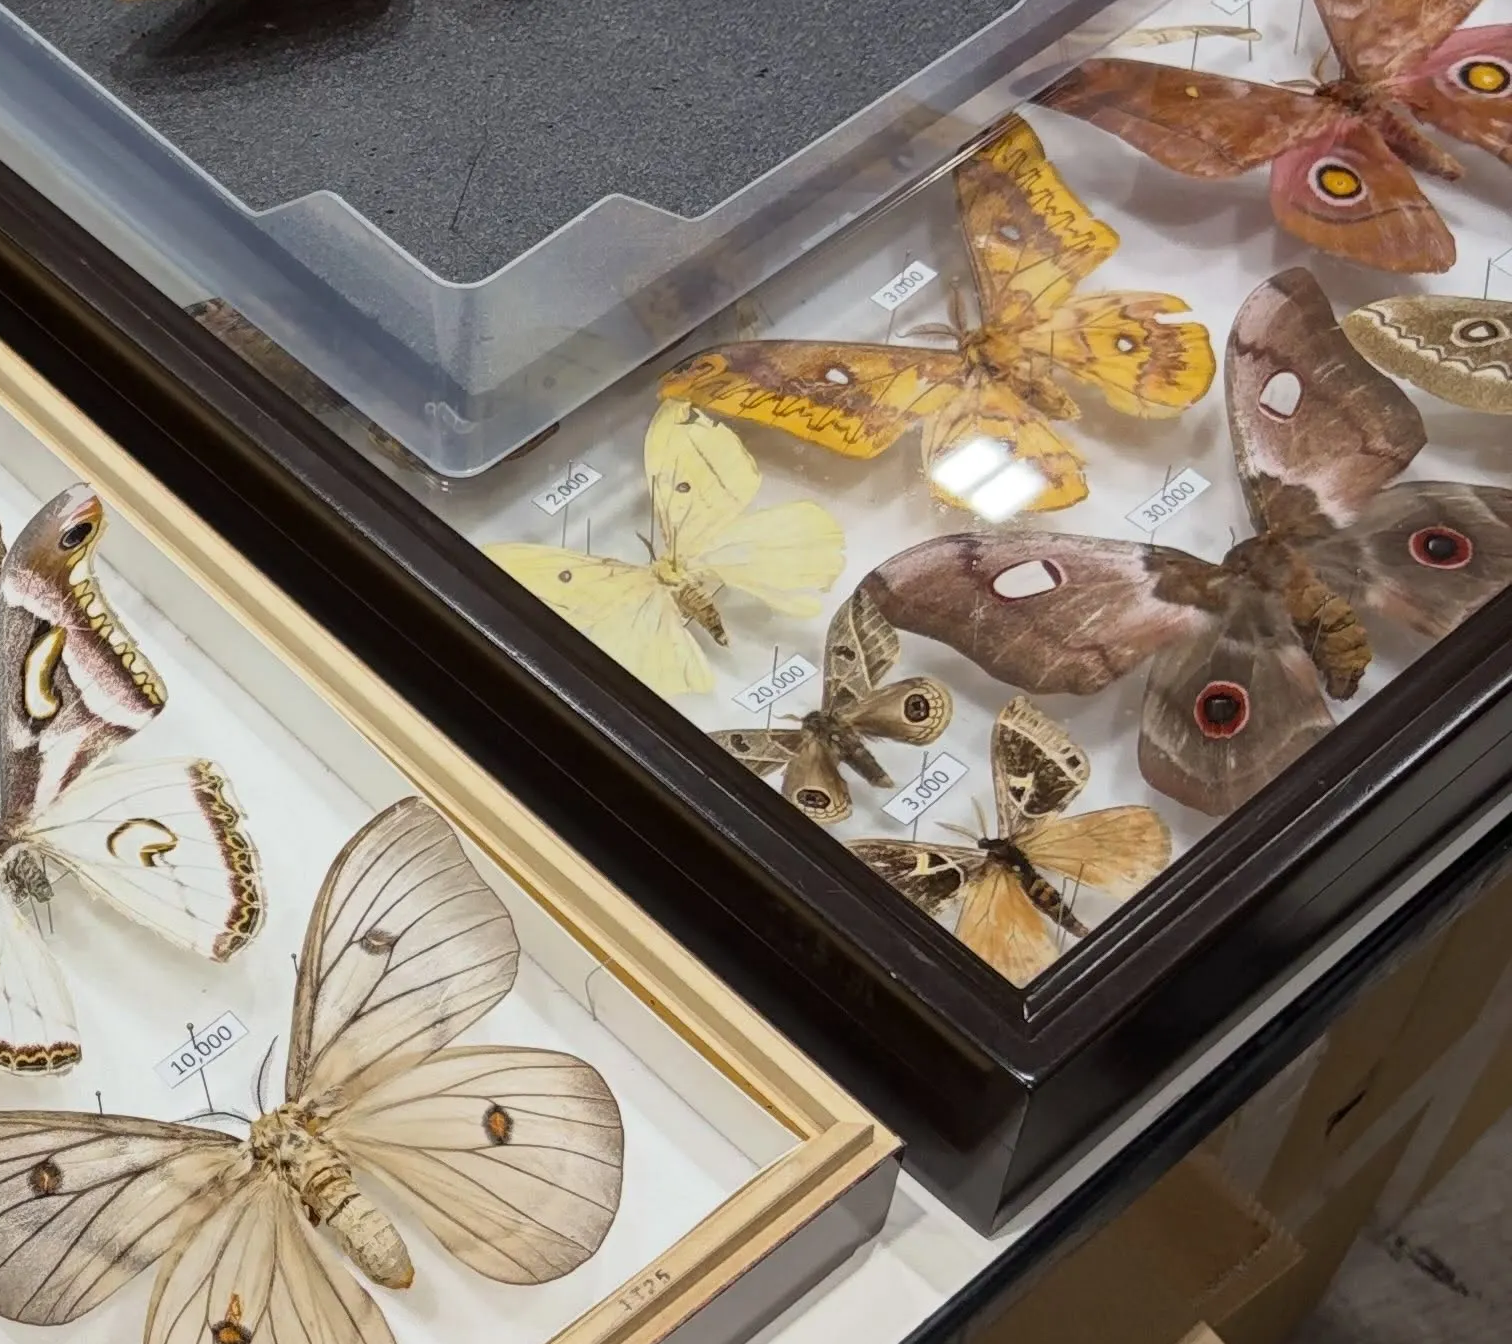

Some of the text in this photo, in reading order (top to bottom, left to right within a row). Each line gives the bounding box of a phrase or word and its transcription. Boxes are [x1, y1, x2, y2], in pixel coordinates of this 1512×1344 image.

[882, 270, 925, 304] 3,000
[545, 472, 590, 506] 2,000
[1142, 481, 1196, 523] 30,000
[747, 664, 806, 704] 20,000
[900, 769, 950, 811] 3,000
[169, 1024, 233, 1076] 10,000
